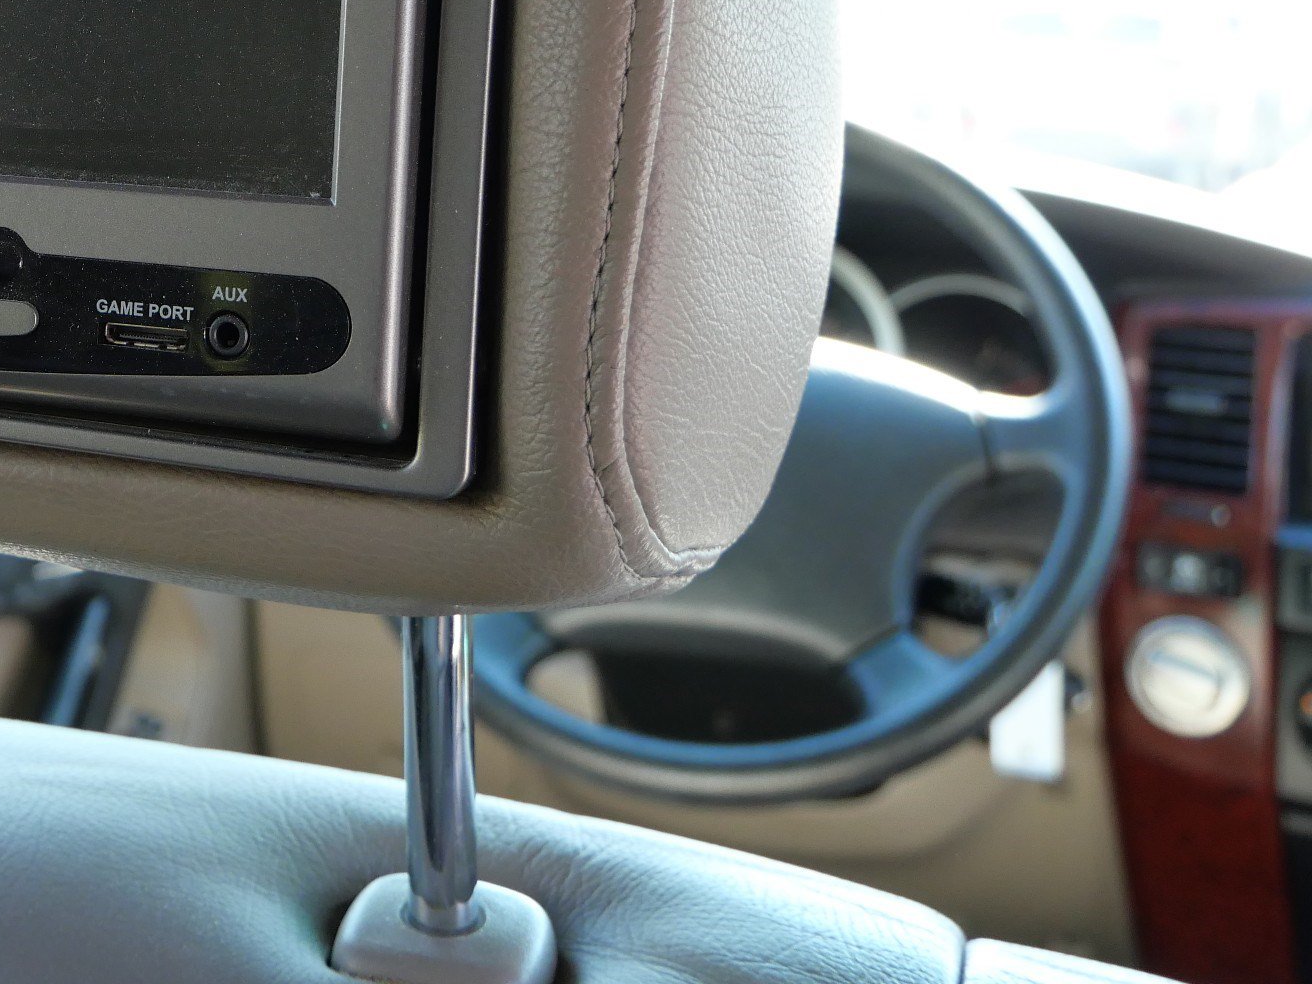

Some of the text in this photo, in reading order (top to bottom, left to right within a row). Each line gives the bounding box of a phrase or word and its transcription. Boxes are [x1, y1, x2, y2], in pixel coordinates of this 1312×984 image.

[212, 286, 248, 303] AUX
[96, 299, 195, 321] GAME PORT
